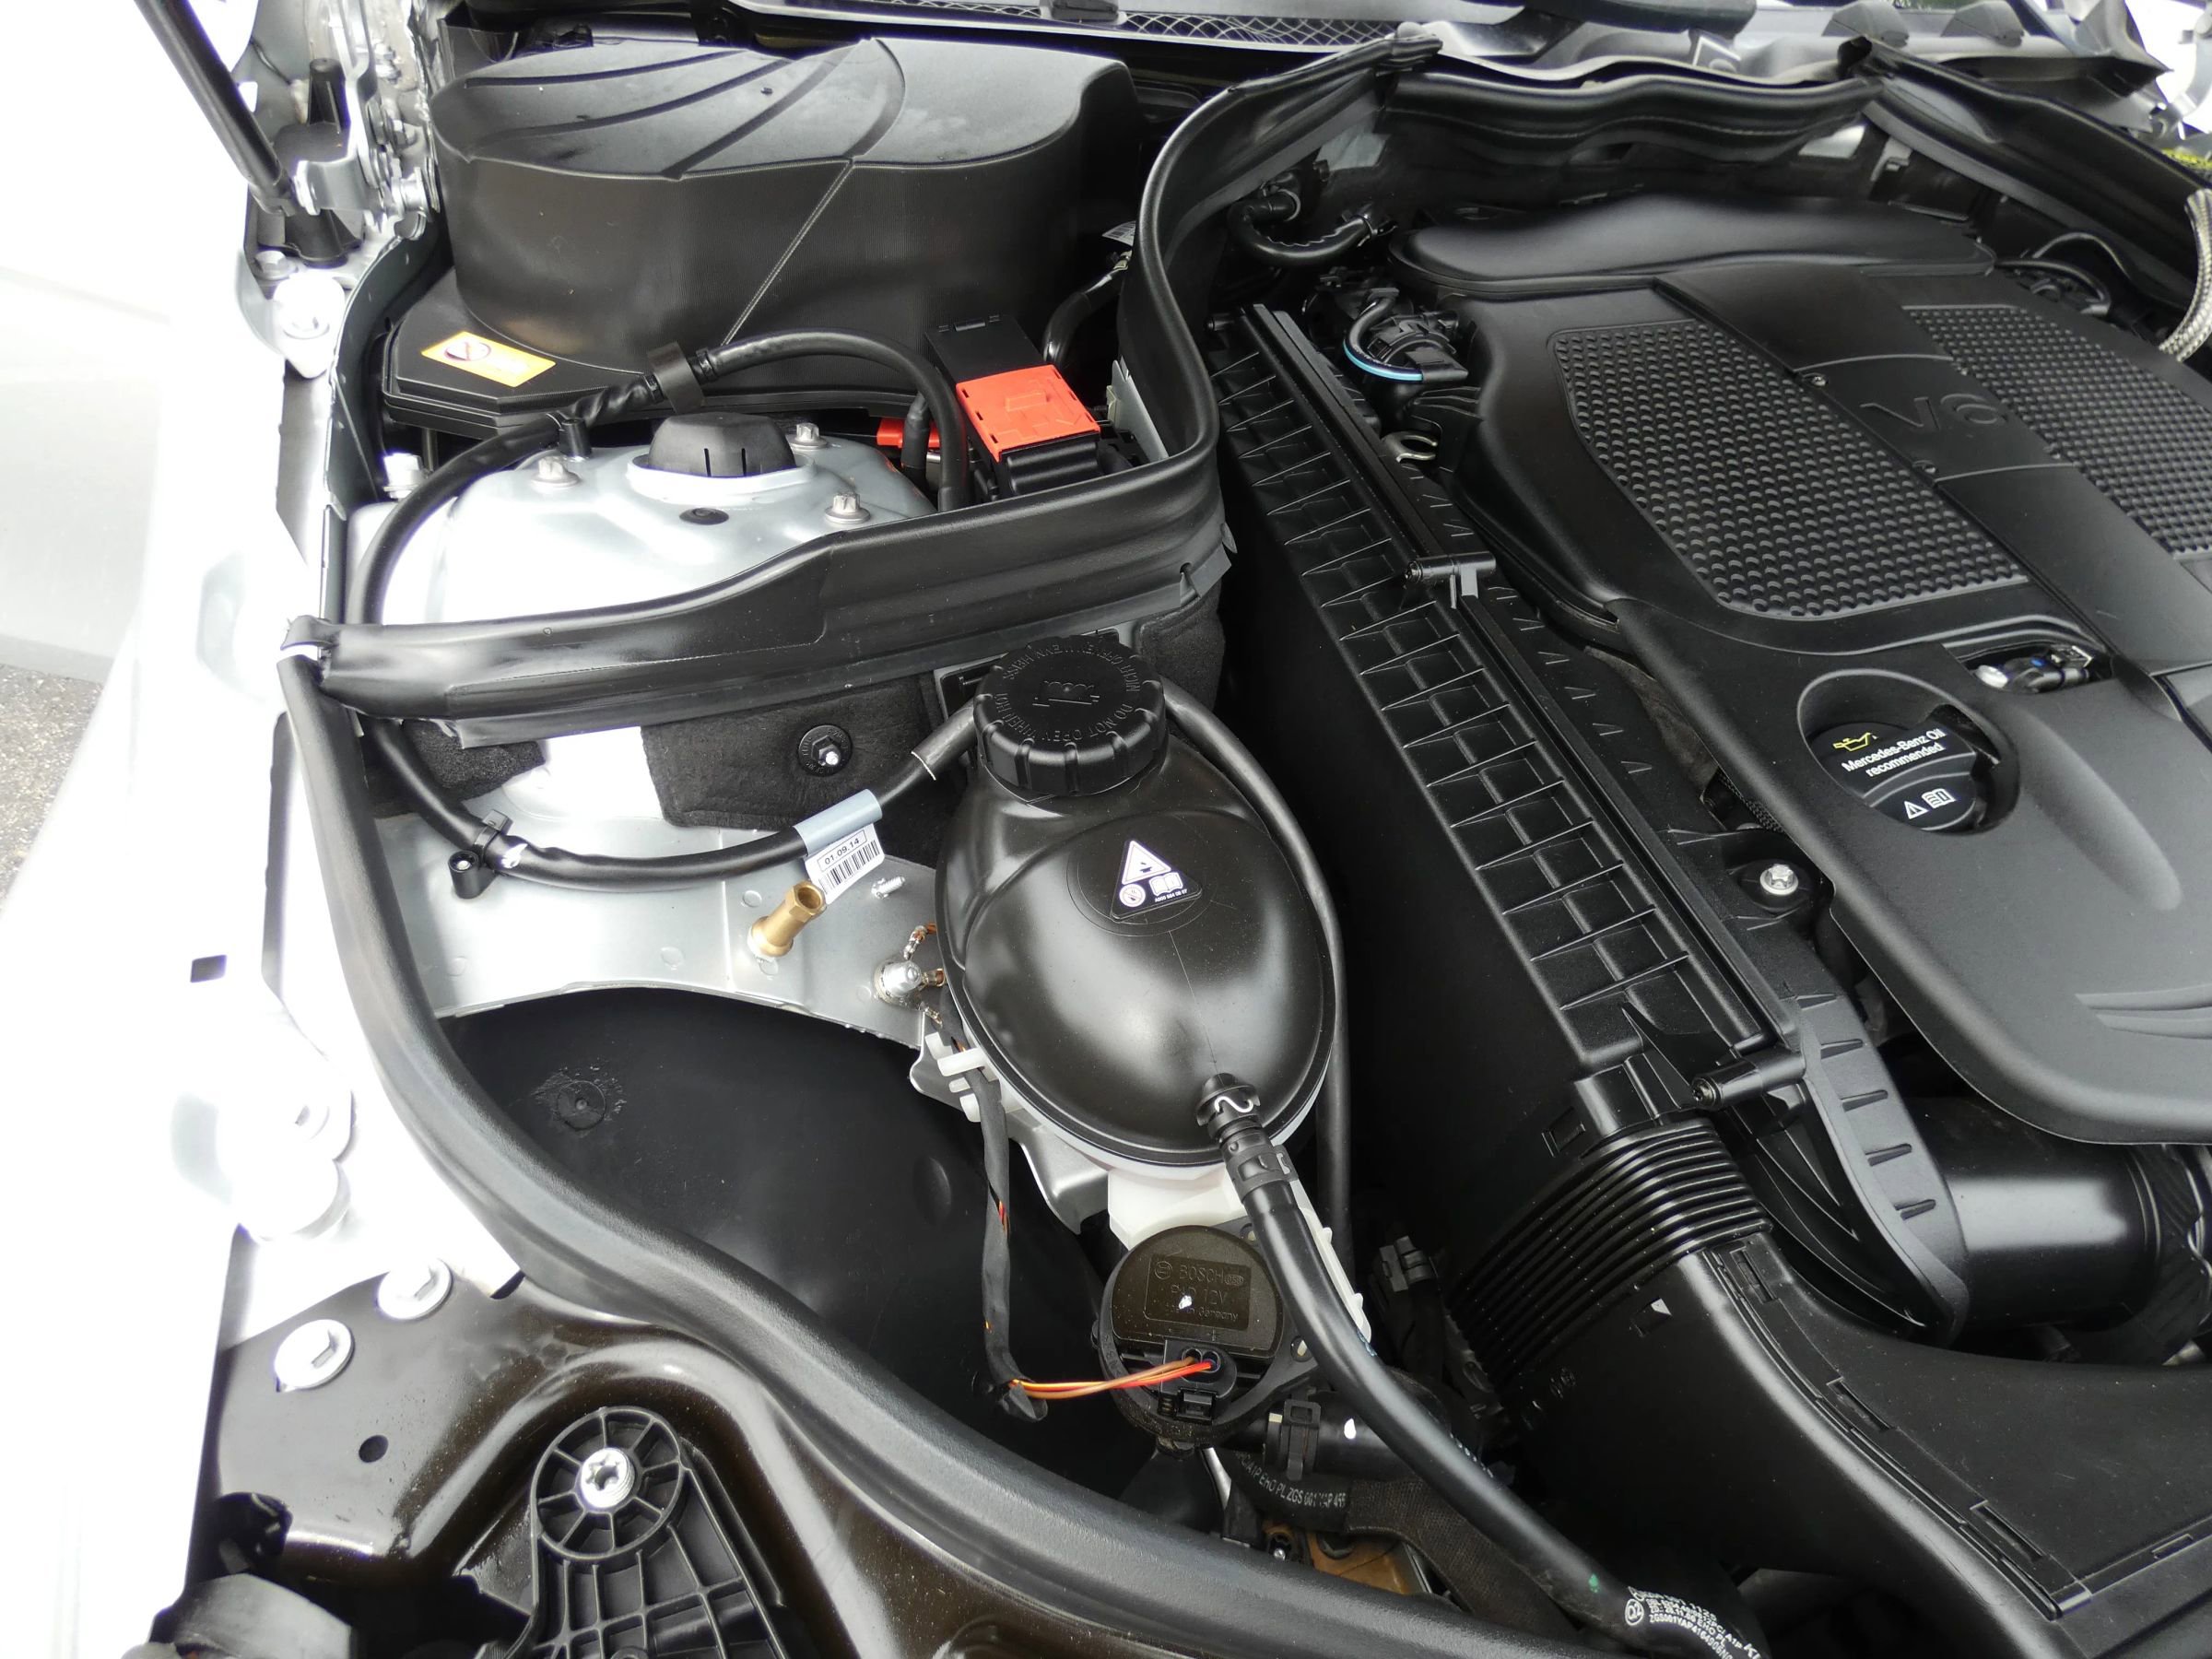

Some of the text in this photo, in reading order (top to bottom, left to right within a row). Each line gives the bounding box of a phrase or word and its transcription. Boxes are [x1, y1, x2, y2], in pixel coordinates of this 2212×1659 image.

[1089, 717, 1118, 737] NOT
[1841, 728, 1947, 771] Mercedes-Benz Oil
[1865, 742, 1946, 777] recommended
[824, 838, 860, 865] 01.09.14
[1178, 1264, 1224, 1284] BOSCH
